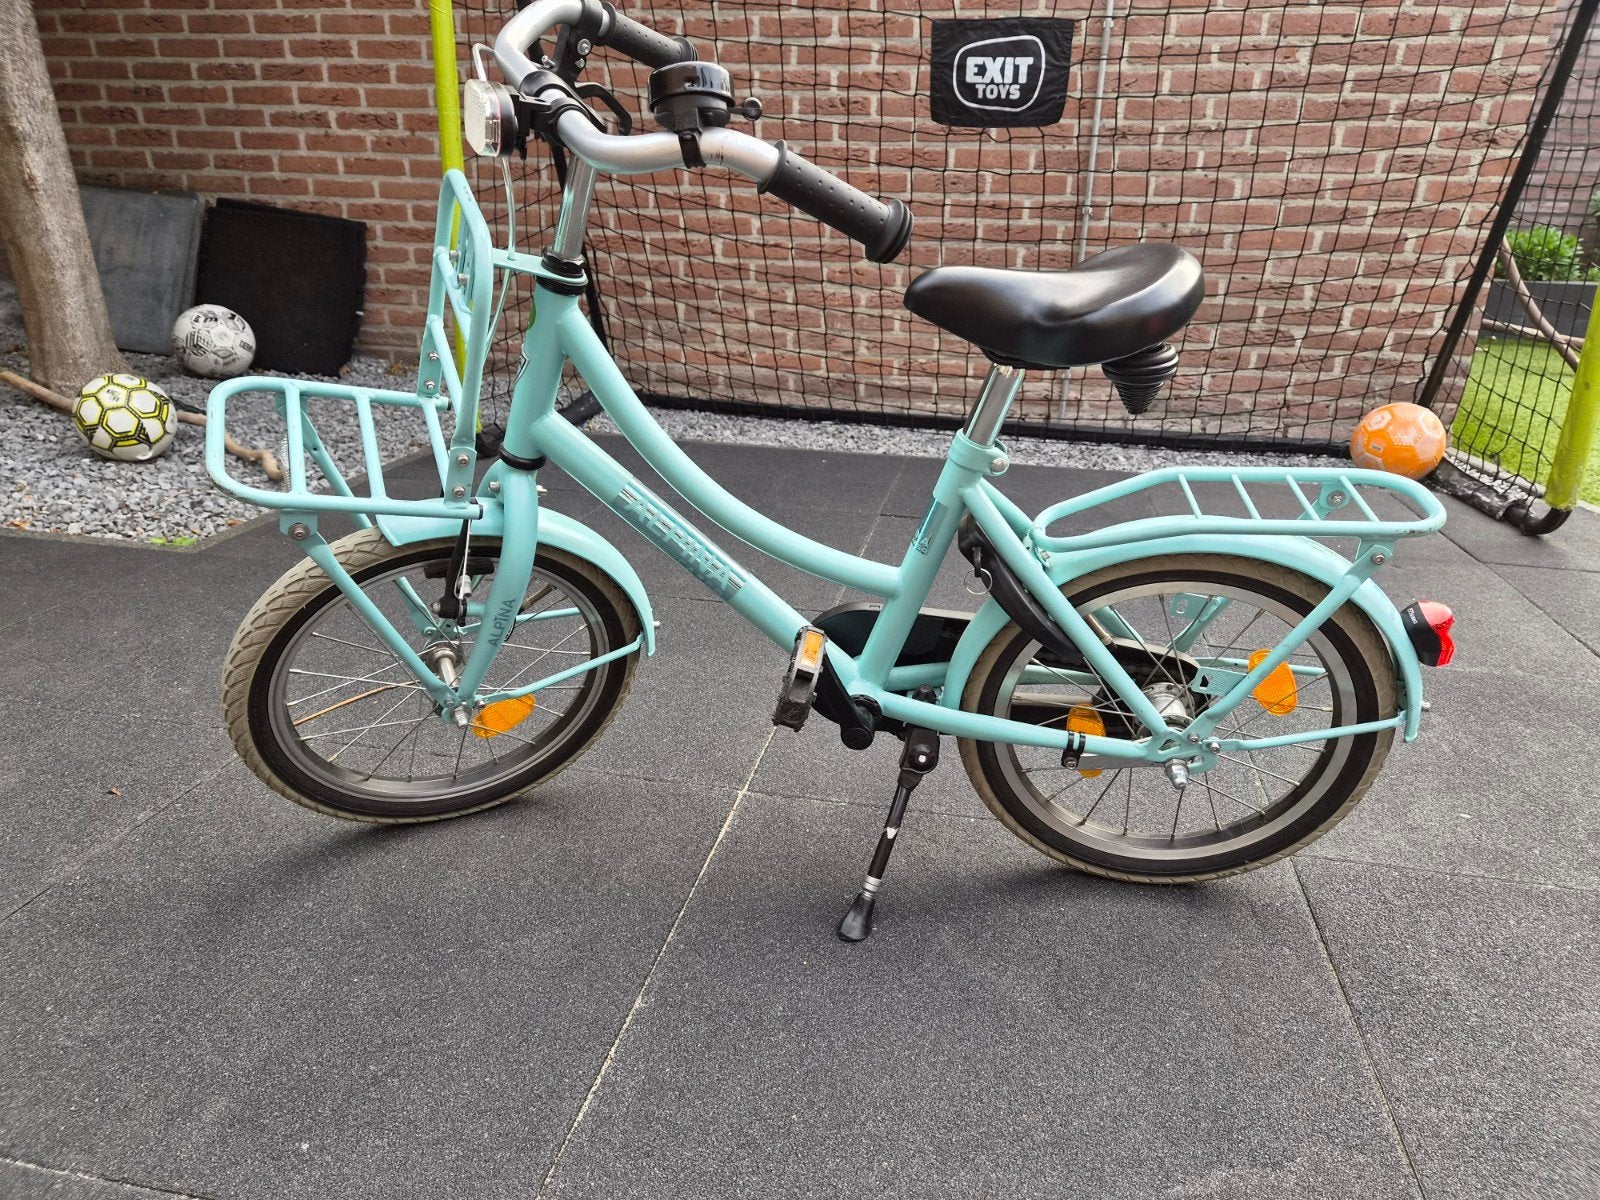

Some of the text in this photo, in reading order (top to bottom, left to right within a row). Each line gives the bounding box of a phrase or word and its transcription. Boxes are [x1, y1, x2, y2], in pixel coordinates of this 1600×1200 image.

[965, 56, 1034, 84] EXIT
[975, 84, 1021, 100] TOYS
[623, 497, 731, 591] ALPINA
[488, 599, 516, 647] ALPINA
